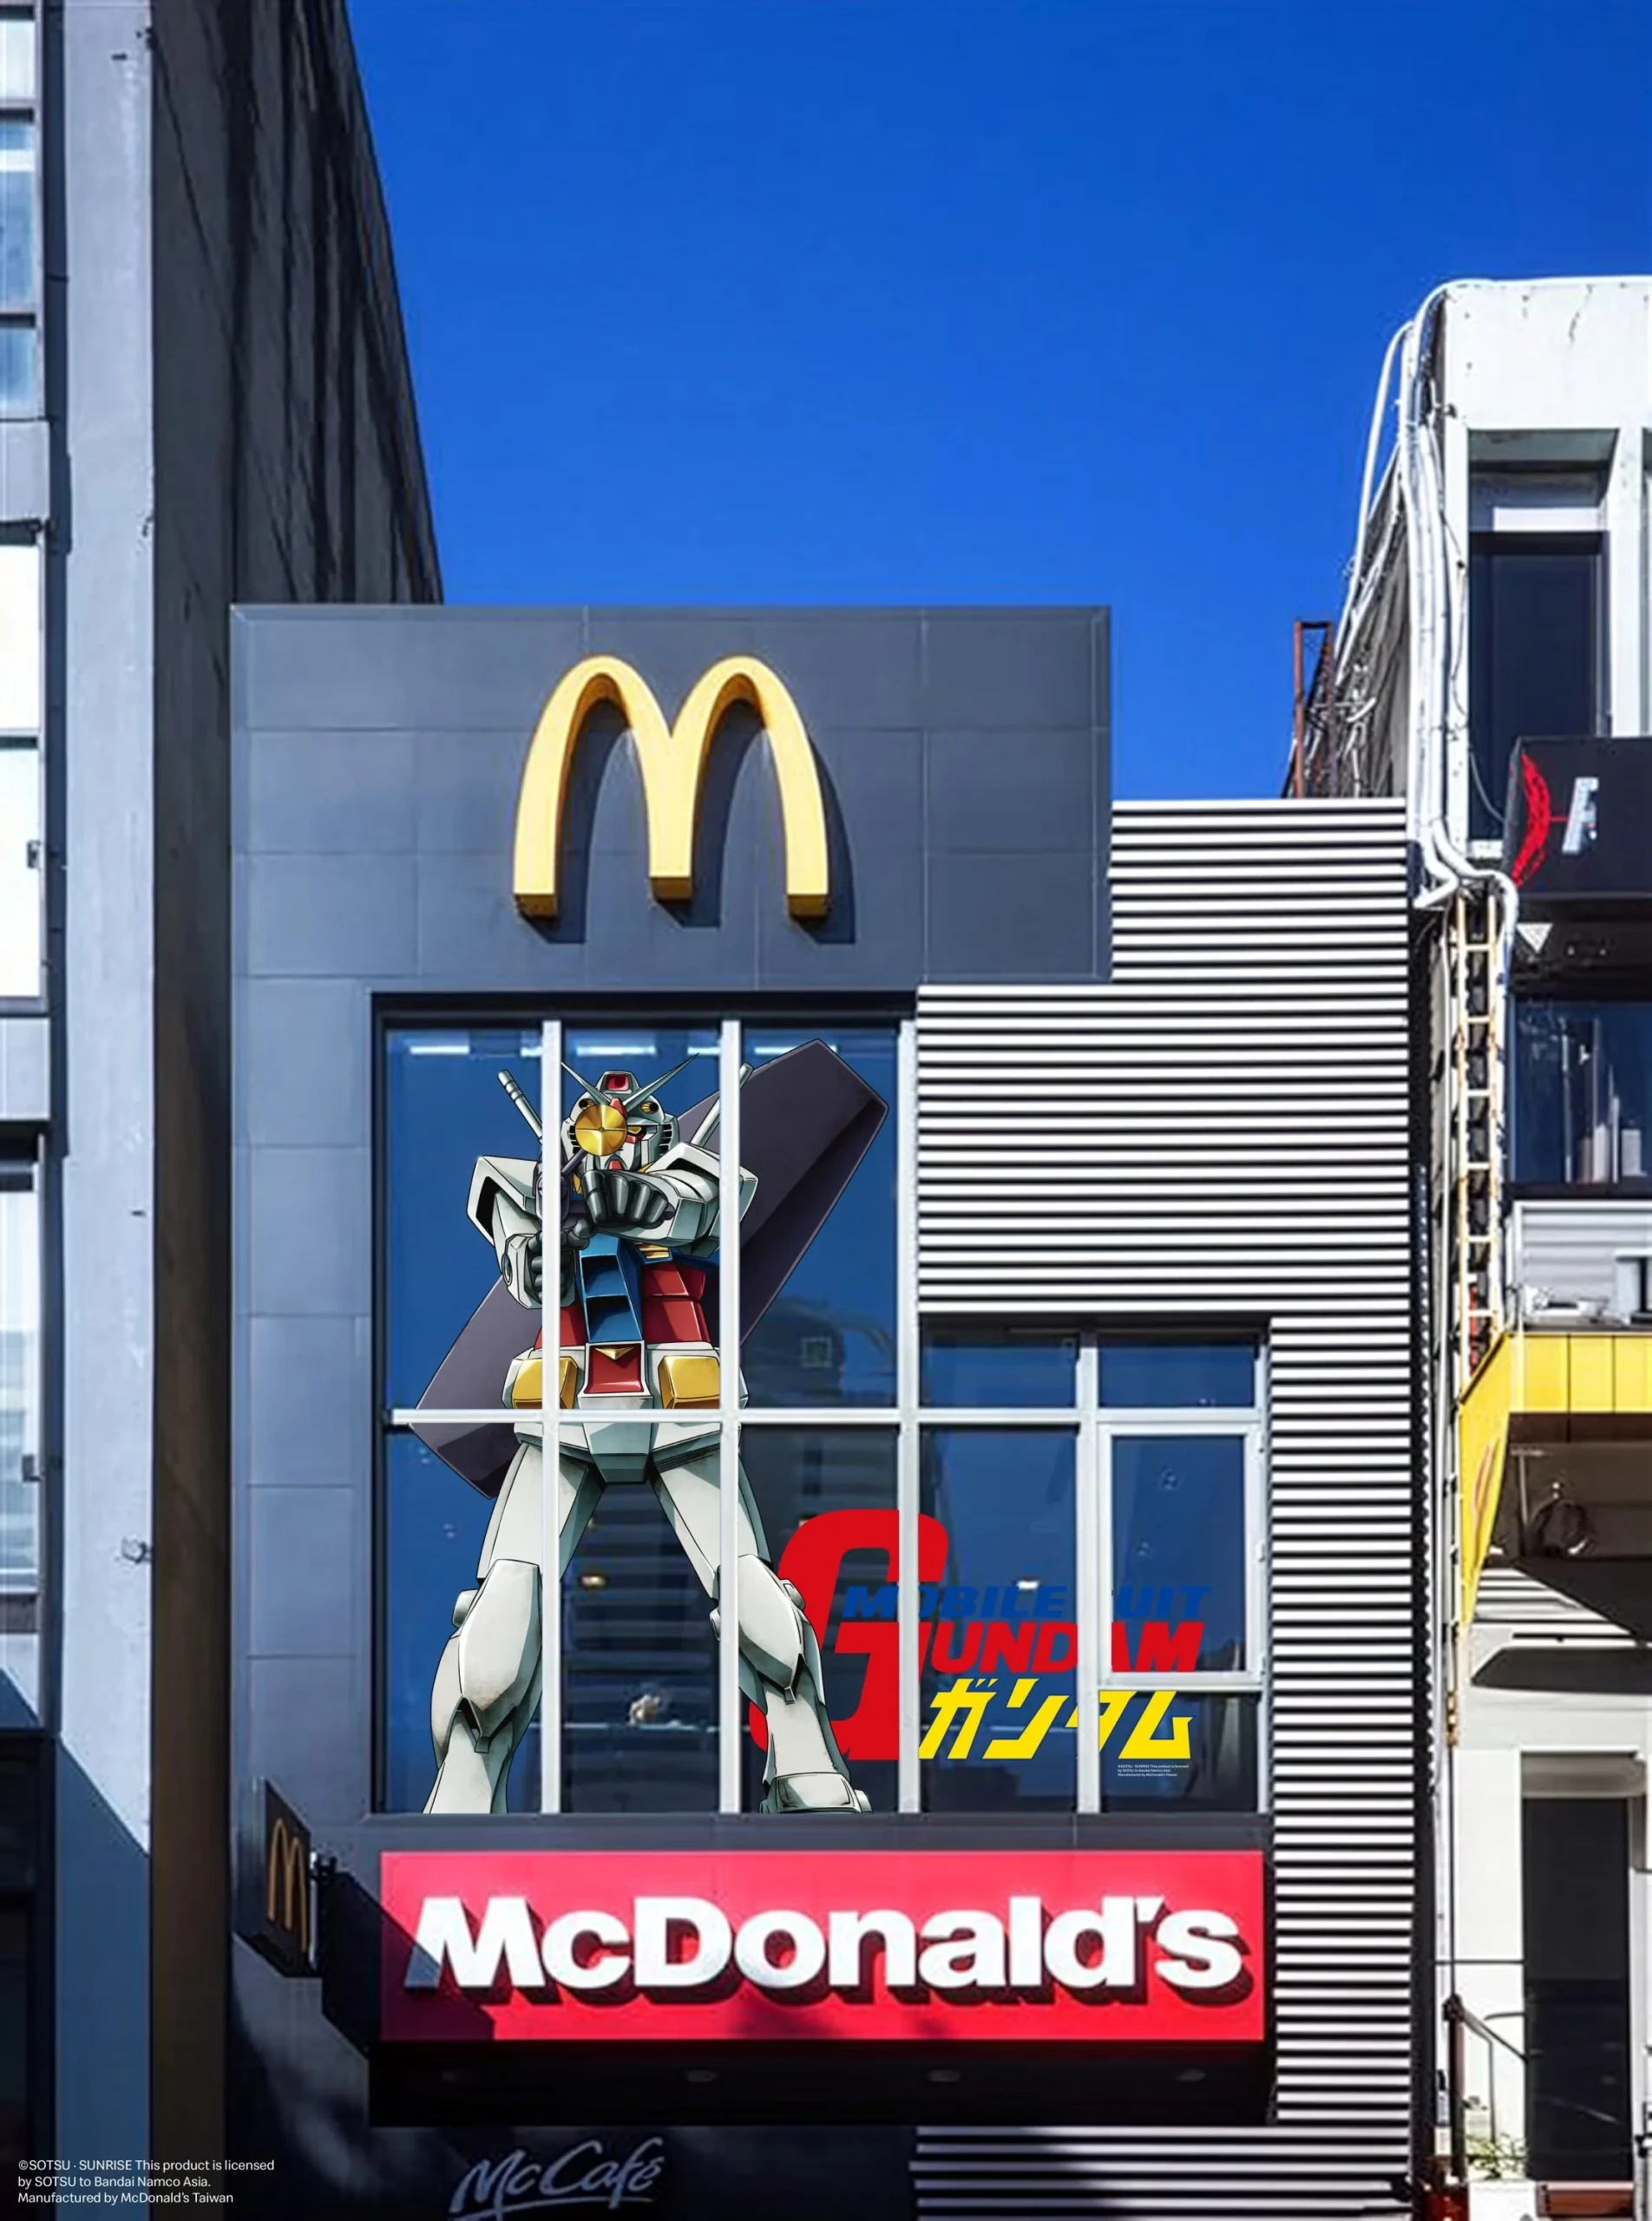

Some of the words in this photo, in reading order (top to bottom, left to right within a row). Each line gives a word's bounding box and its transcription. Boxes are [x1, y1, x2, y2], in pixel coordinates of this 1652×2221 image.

[1116, 1585, 1213, 1619] UIT
[403, 1896, 1242, 1989] McDonald's
[448, 2136, 665, 2221] McCafé
